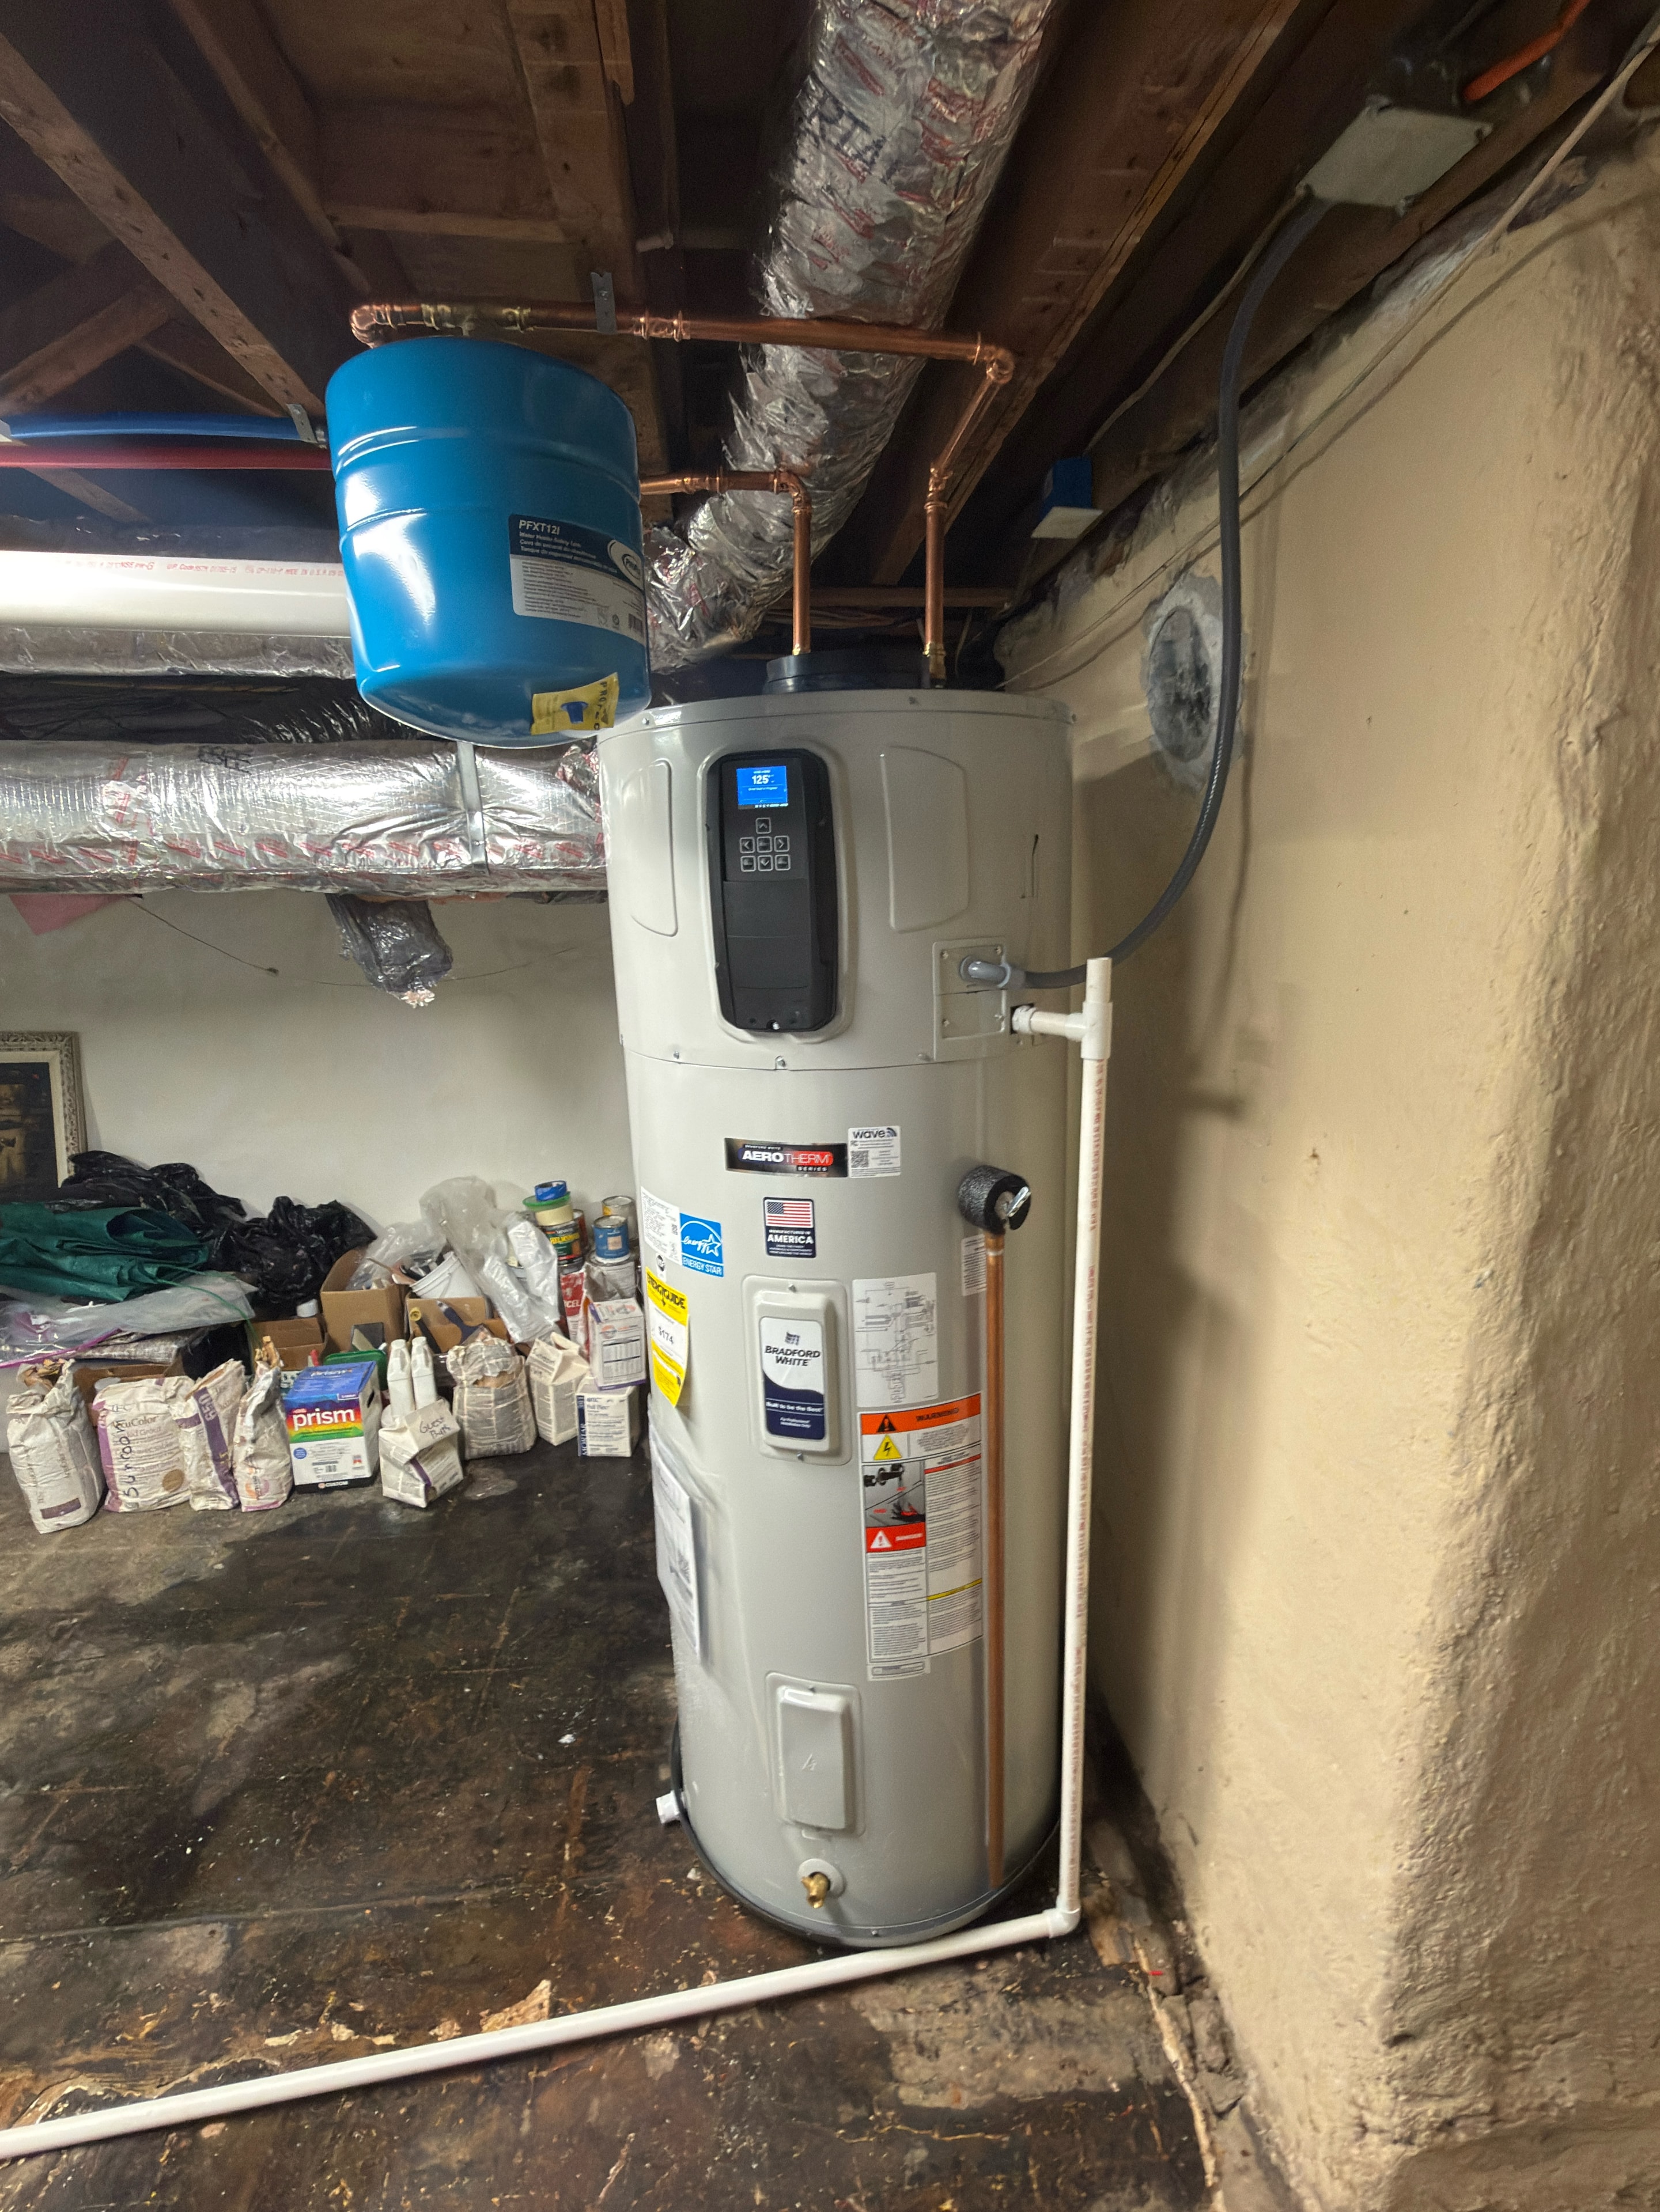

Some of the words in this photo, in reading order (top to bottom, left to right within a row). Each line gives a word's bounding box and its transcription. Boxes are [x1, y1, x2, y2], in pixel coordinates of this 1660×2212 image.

[519, 520, 560, 535] PFXT12I
[853, 1130, 886, 1138] wave
[742, 1150, 829, 1164] AEROTHERM
[767, 1234, 814, 1244] AMERICA
[682, 1256, 704, 1268] ENERGY
[705, 1263, 723, 1275] STAR
[765, 1345, 821, 1358] BRADFORD
[776, 1355, 809, 1366] WHITE
[293, 1408, 355, 1431] prism
